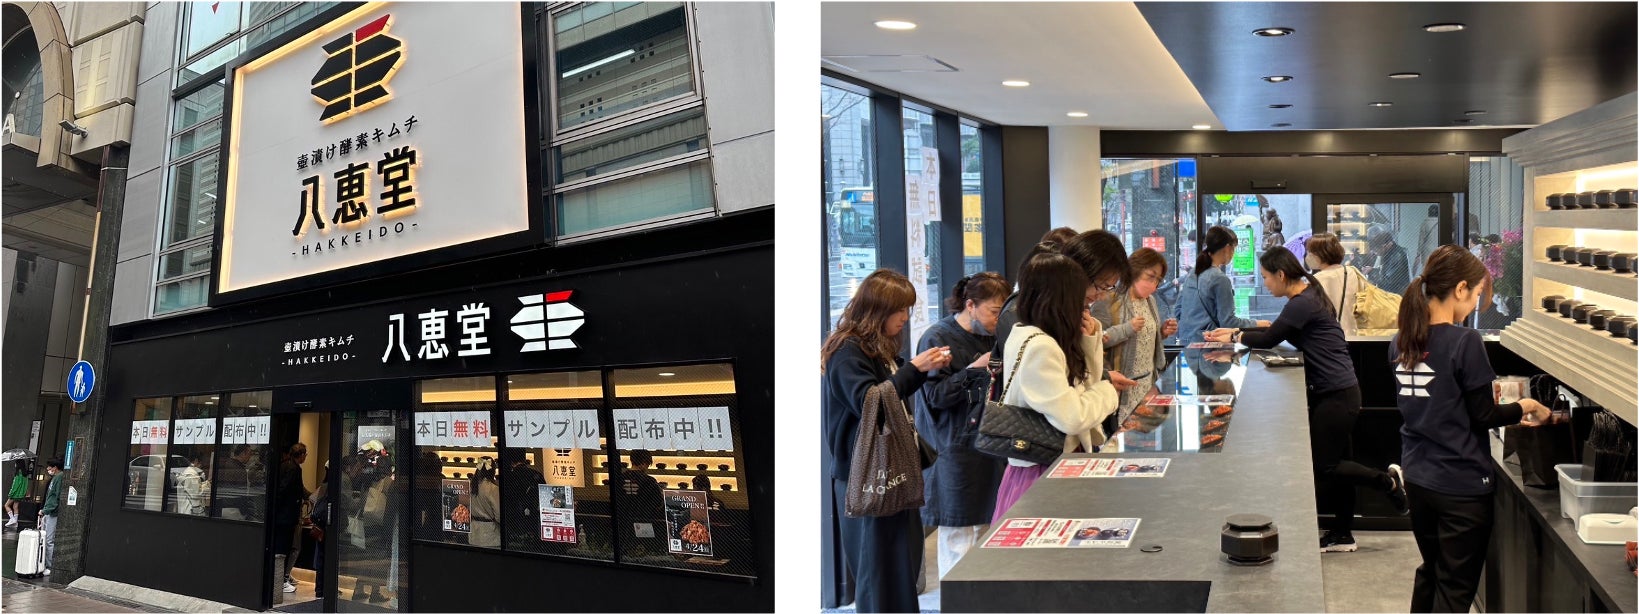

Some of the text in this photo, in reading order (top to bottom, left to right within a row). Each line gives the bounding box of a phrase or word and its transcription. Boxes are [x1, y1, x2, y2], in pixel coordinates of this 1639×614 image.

[292, 146, 417, 236] 八恵堂
[382, 302, 491, 363] 八恵堂
[133, 426, 168, 439] 本日無料
[175, 425, 215, 439] サンプル
[417, 419, 489, 439] 本日無料
[507, 418, 596, 438] サンプル
